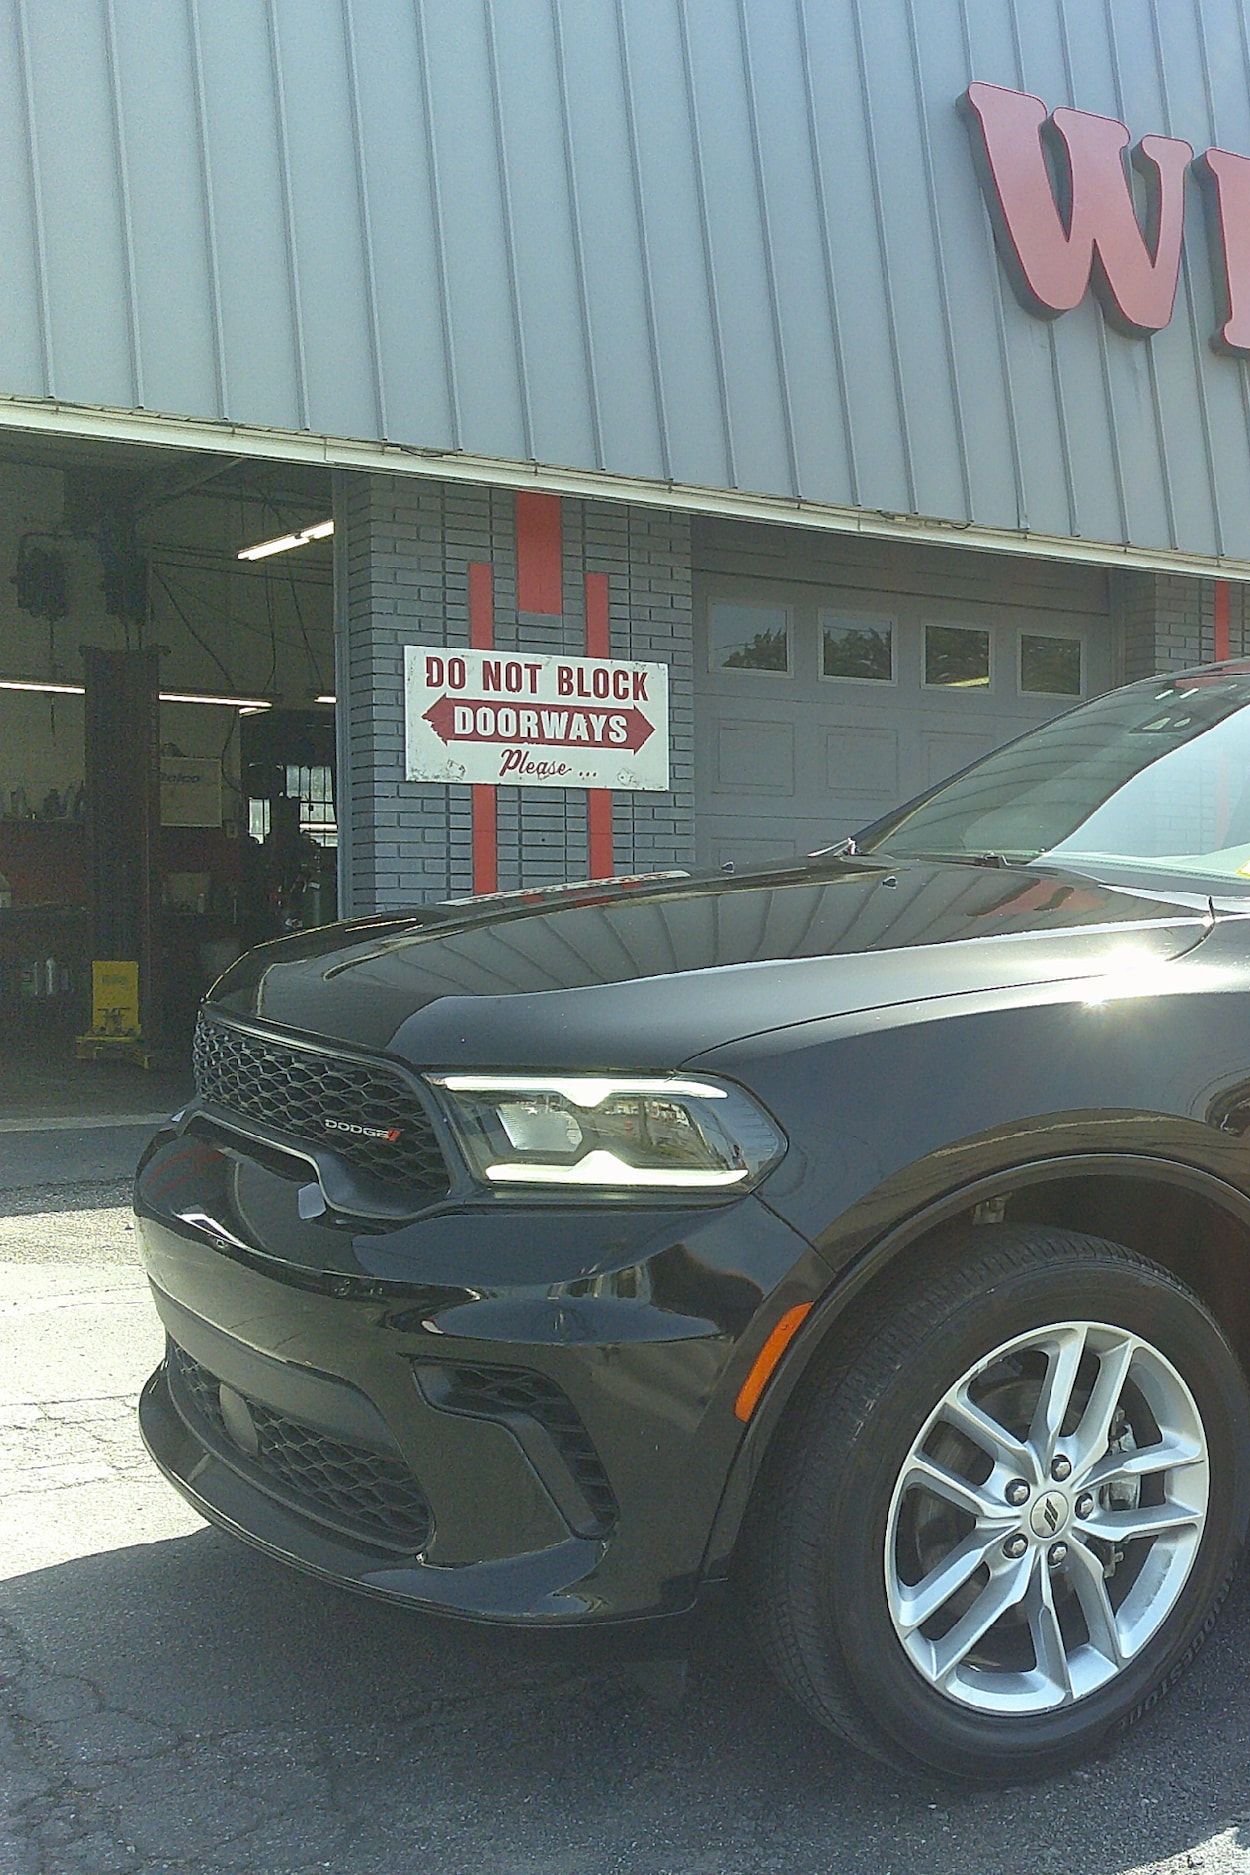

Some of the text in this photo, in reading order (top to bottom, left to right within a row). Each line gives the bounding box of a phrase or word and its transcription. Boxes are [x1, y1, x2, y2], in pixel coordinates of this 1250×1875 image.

[425, 656, 650, 702] DO NOT BLOCK
[453, 705, 629, 744] DOORWAYS
[498, 748, 573, 777] Please
[324, 1118, 390, 1139] DODGE
